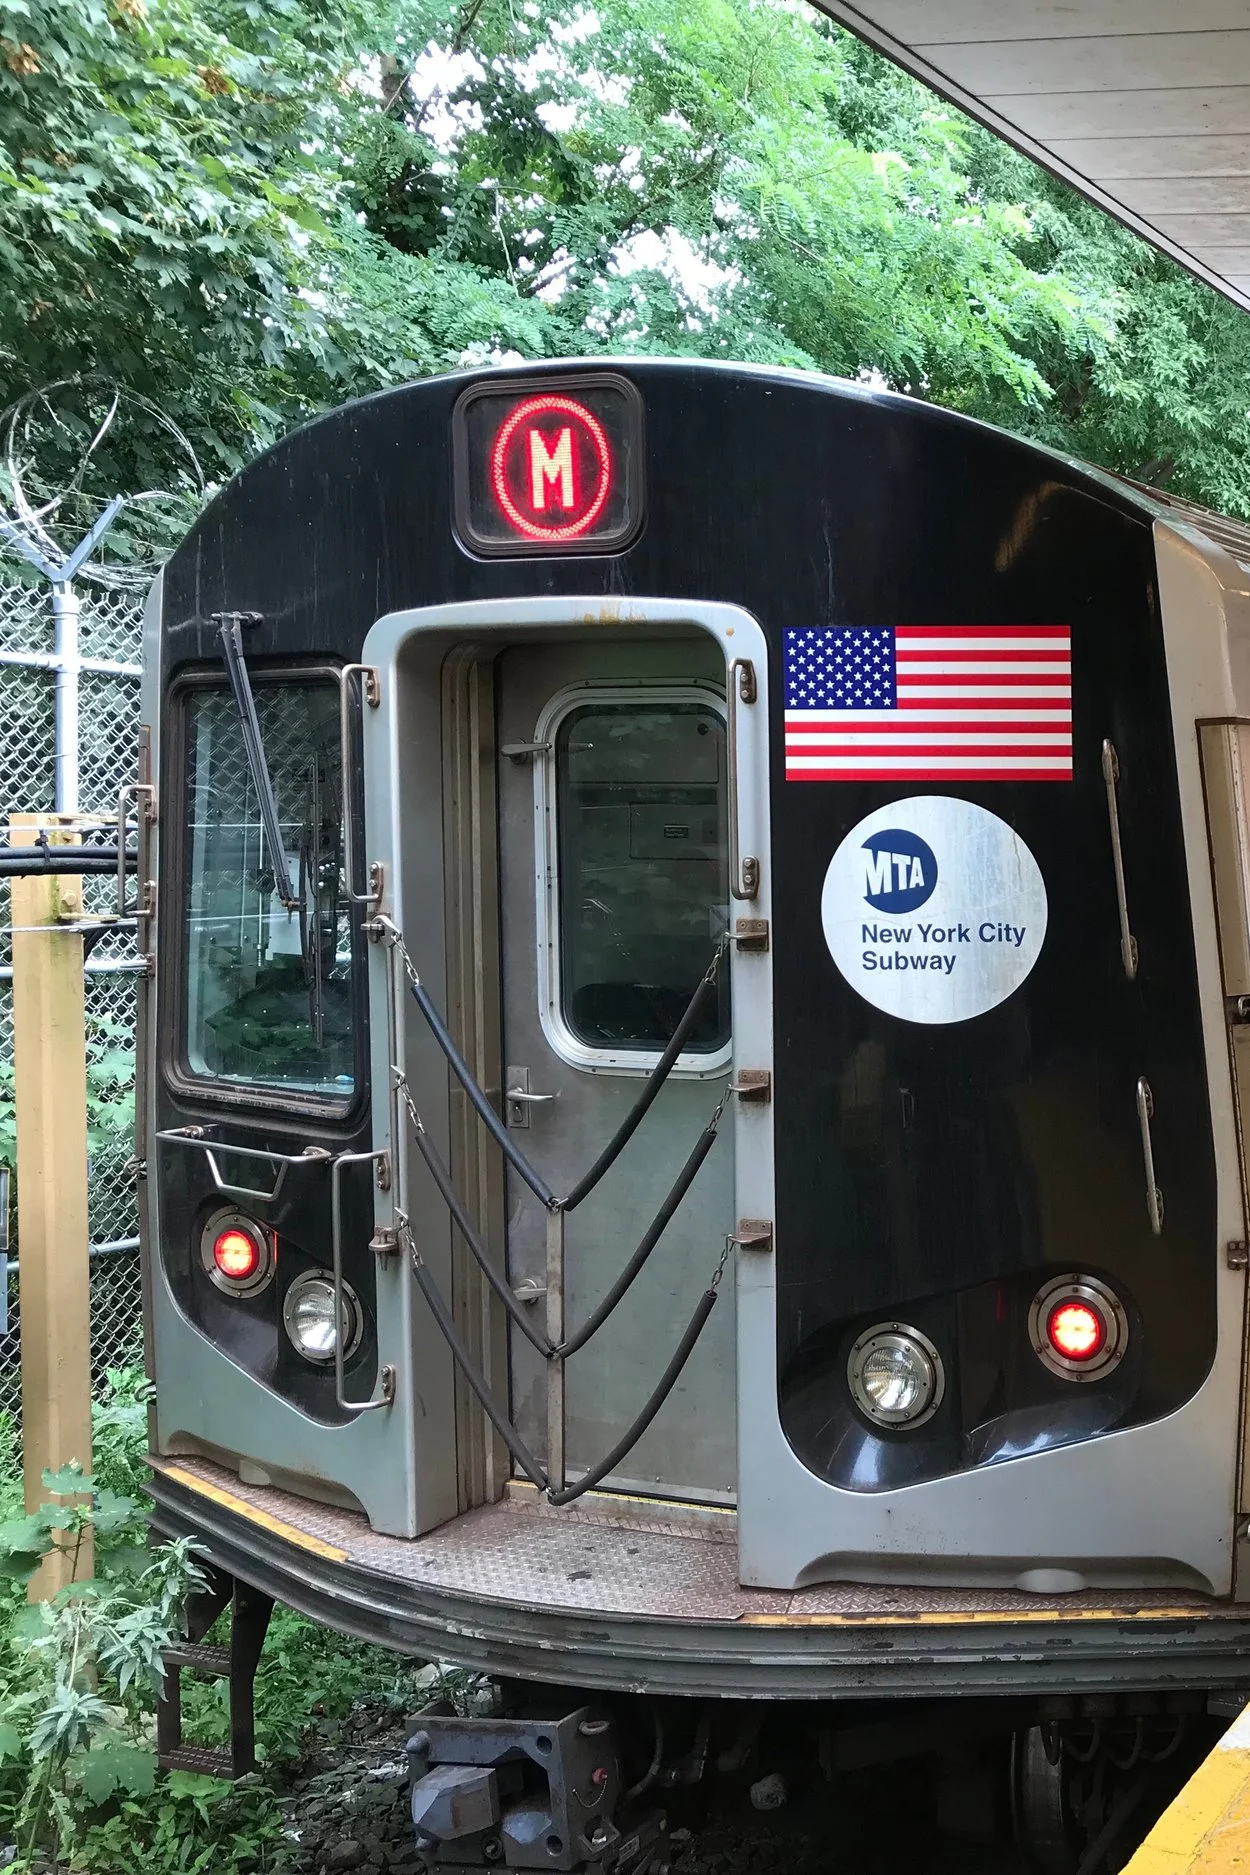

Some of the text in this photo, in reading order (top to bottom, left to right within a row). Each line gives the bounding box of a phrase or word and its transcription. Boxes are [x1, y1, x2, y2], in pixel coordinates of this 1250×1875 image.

[530, 428, 574, 509] M
[861, 848, 925, 896] MTA
[862, 922, 1026, 947] New York City
[862, 951, 957, 975] Subway
